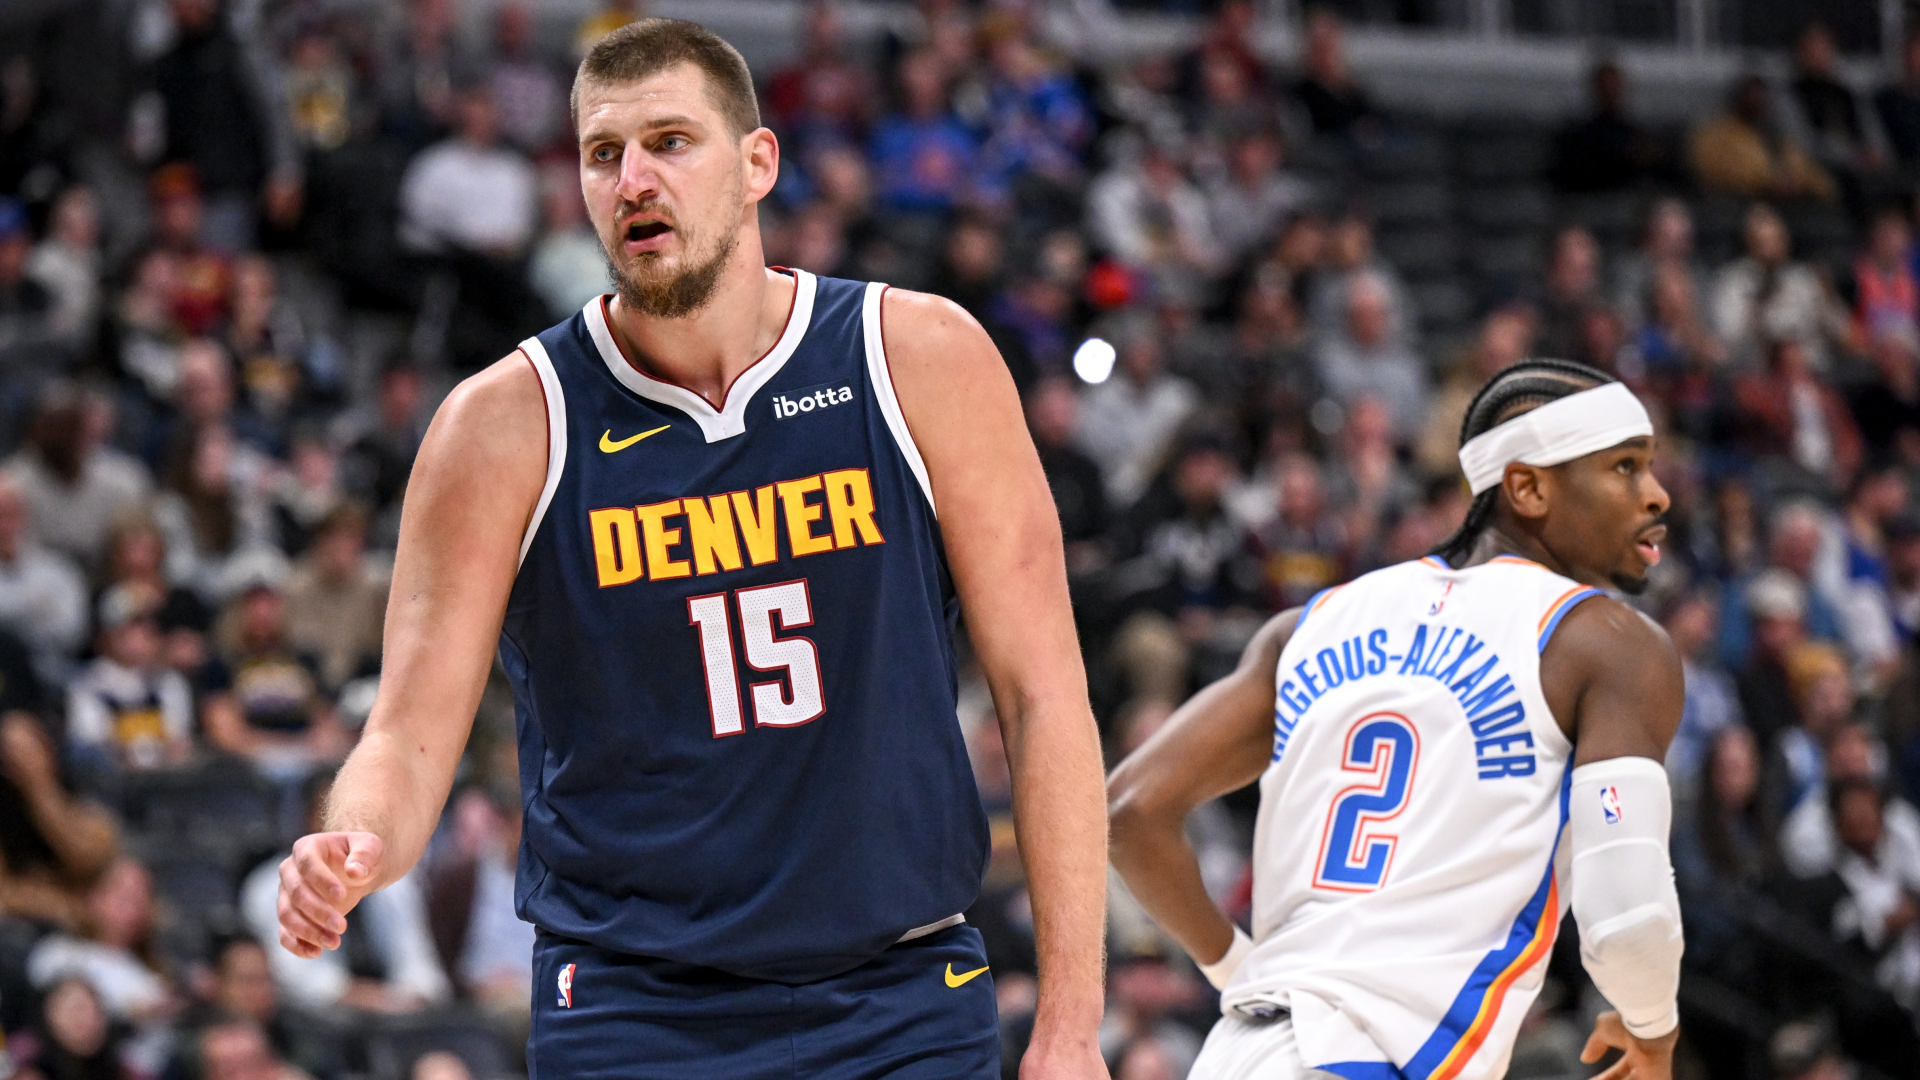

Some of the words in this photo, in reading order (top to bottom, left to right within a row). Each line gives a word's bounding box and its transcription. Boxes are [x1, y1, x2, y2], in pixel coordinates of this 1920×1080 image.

[772, 386, 853, 418] ibotta
[589, 468, 886, 588] DENVER
[687, 578, 826, 738] 15
[1312, 711, 1420, 893] 2
